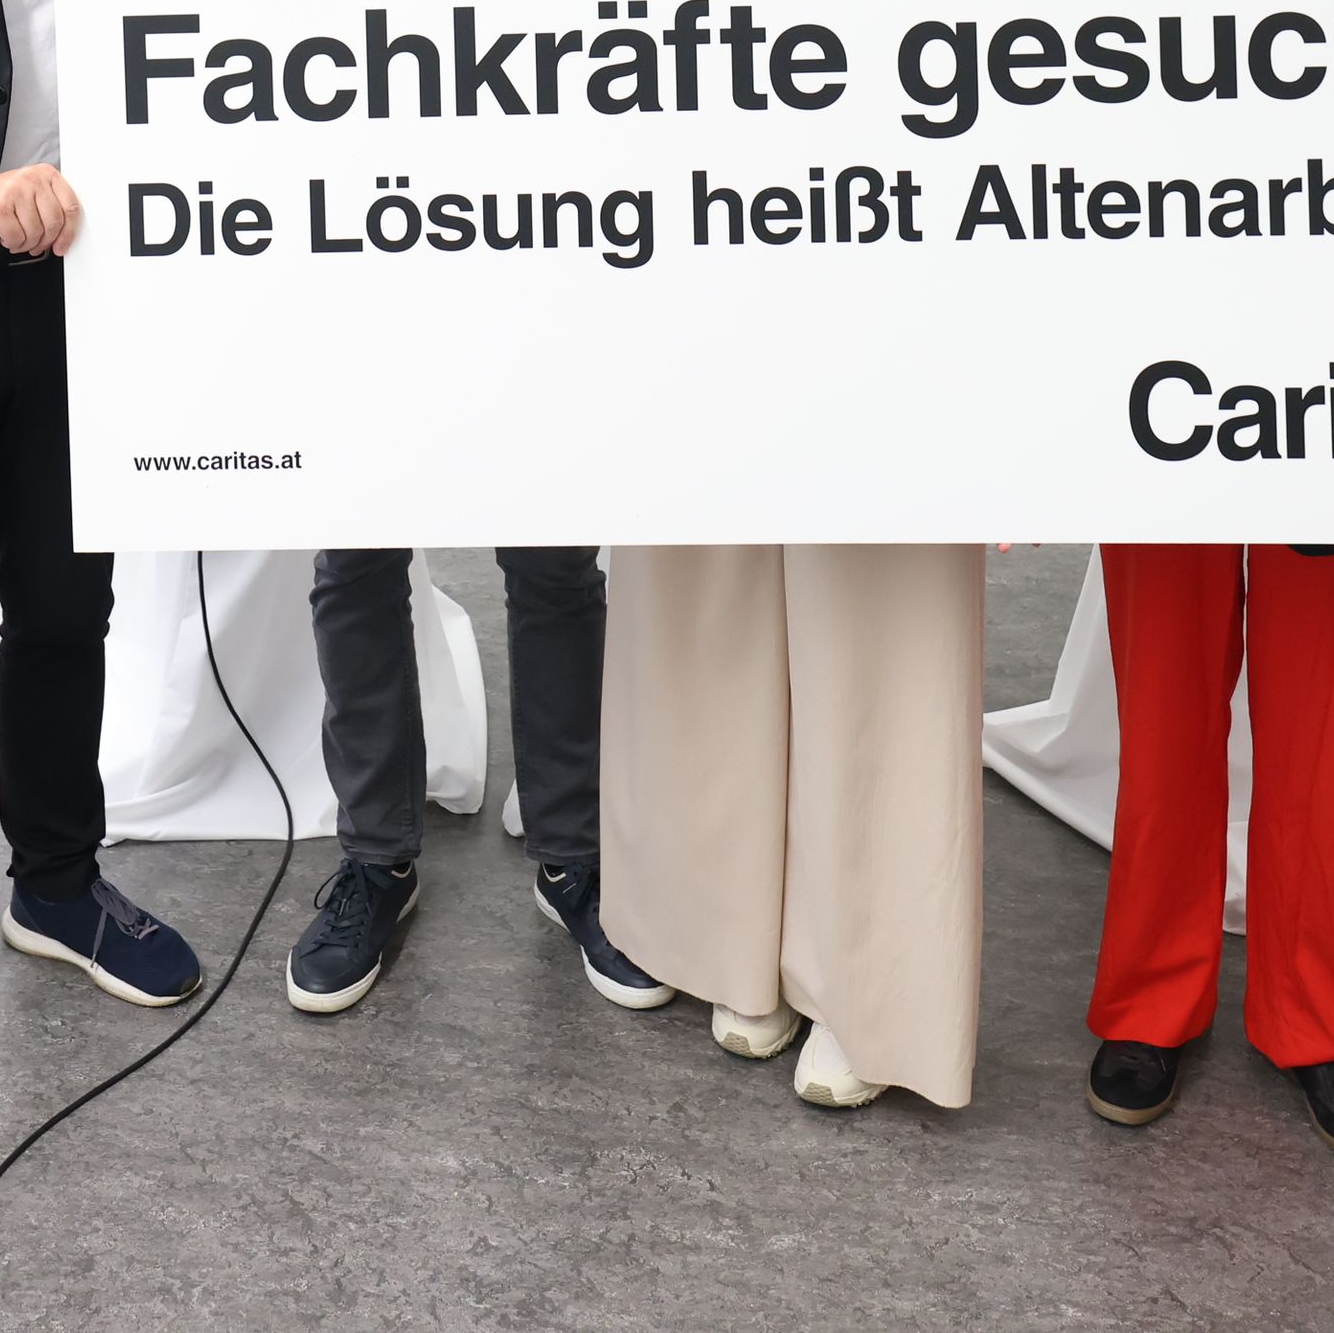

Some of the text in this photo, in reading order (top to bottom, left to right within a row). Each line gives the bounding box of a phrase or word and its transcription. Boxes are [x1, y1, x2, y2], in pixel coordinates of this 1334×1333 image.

[122, 0, 848, 125] Fachkräfte
[128, 181, 273, 257] Die
[309, 176, 654, 269] Lösung
[692, 165, 923, 246] heißt
[133, 451, 302, 471] www.caritas.at
